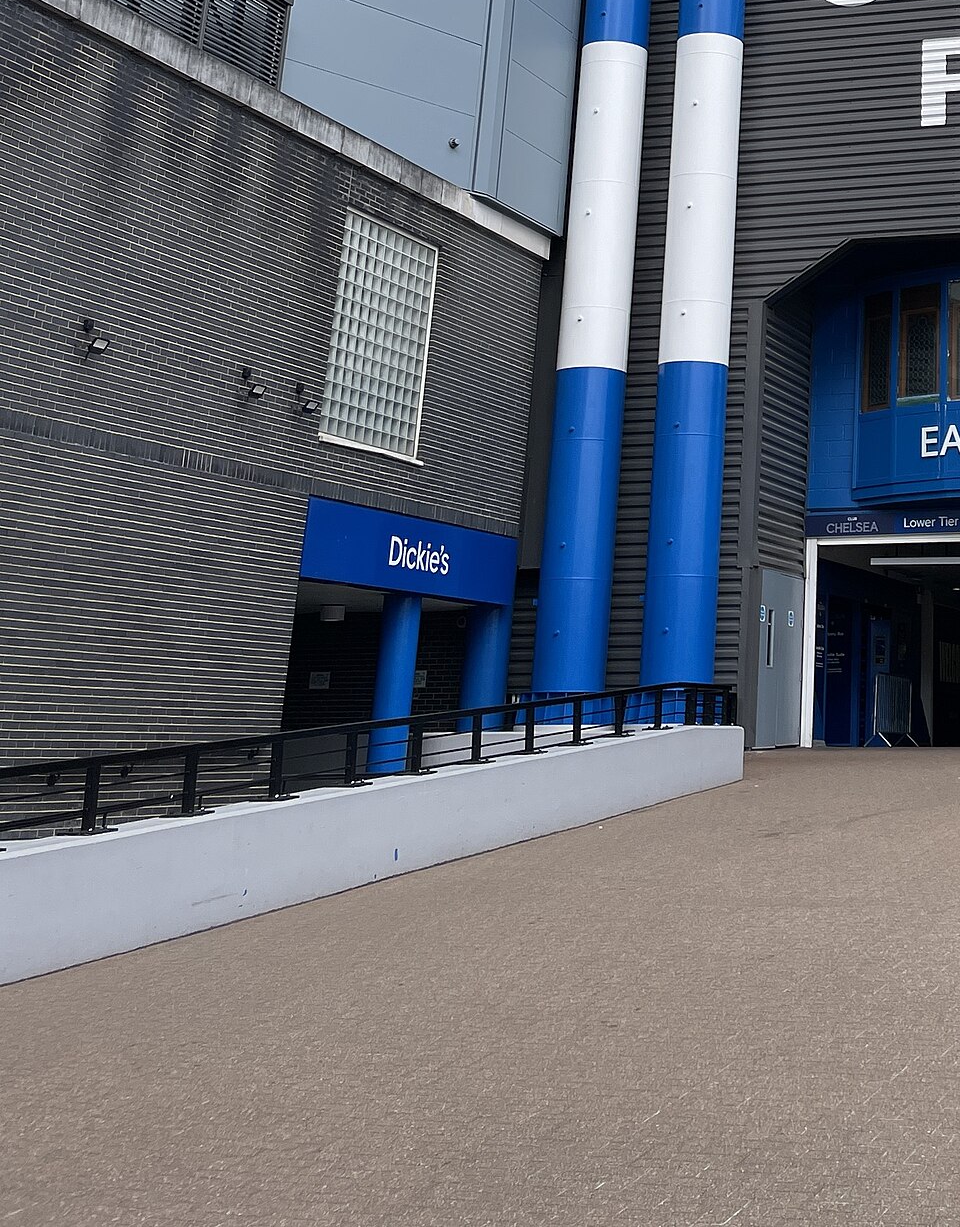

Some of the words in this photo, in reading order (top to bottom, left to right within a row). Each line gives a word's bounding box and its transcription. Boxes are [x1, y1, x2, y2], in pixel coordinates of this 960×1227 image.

[826, 521, 879, 534] CHELSEA
[903, 517, 936, 528] Lower
[938, 515, 960, 527] Tier
[388, 535, 450, 575] Dickie's
